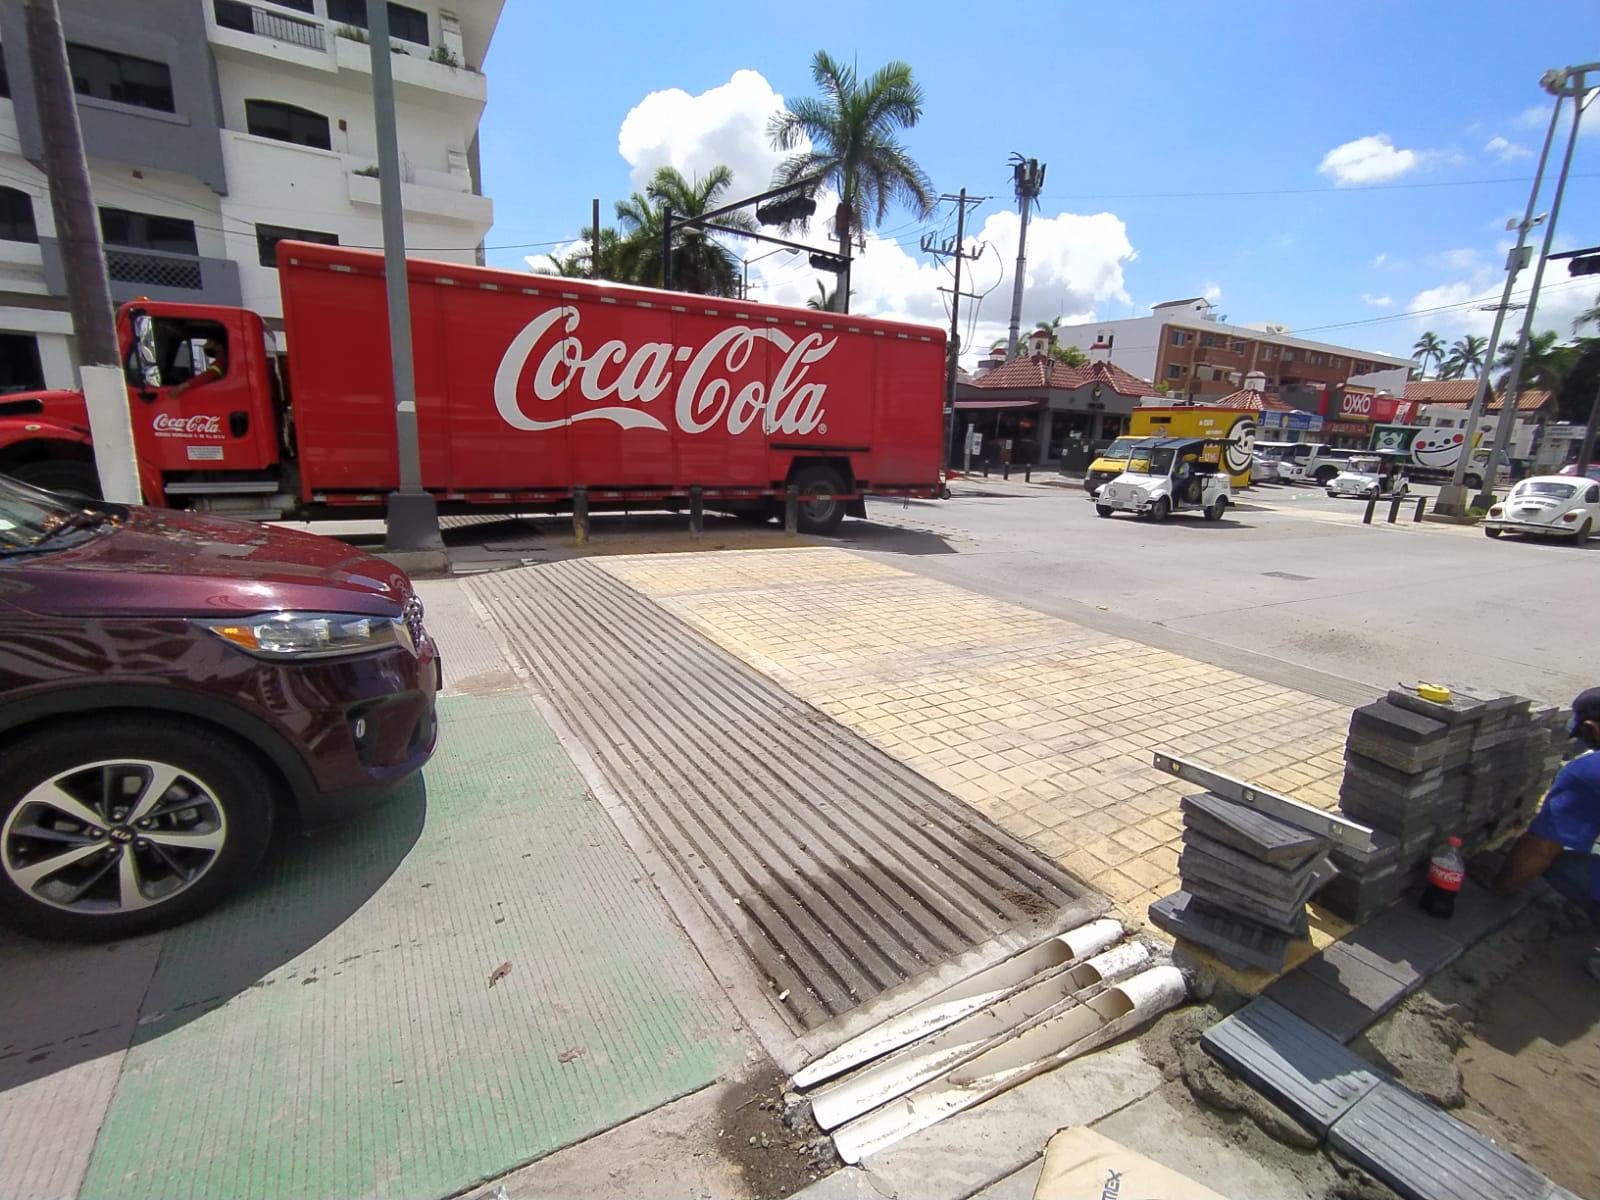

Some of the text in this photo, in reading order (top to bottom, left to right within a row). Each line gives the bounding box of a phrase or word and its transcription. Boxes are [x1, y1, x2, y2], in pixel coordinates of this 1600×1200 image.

[494, 305, 839, 435] Coca-Cola
[1343, 393, 1371, 414] OXXO
[153, 413, 220, 432] Coca-Cola
[111, 829, 131, 840] KIA
